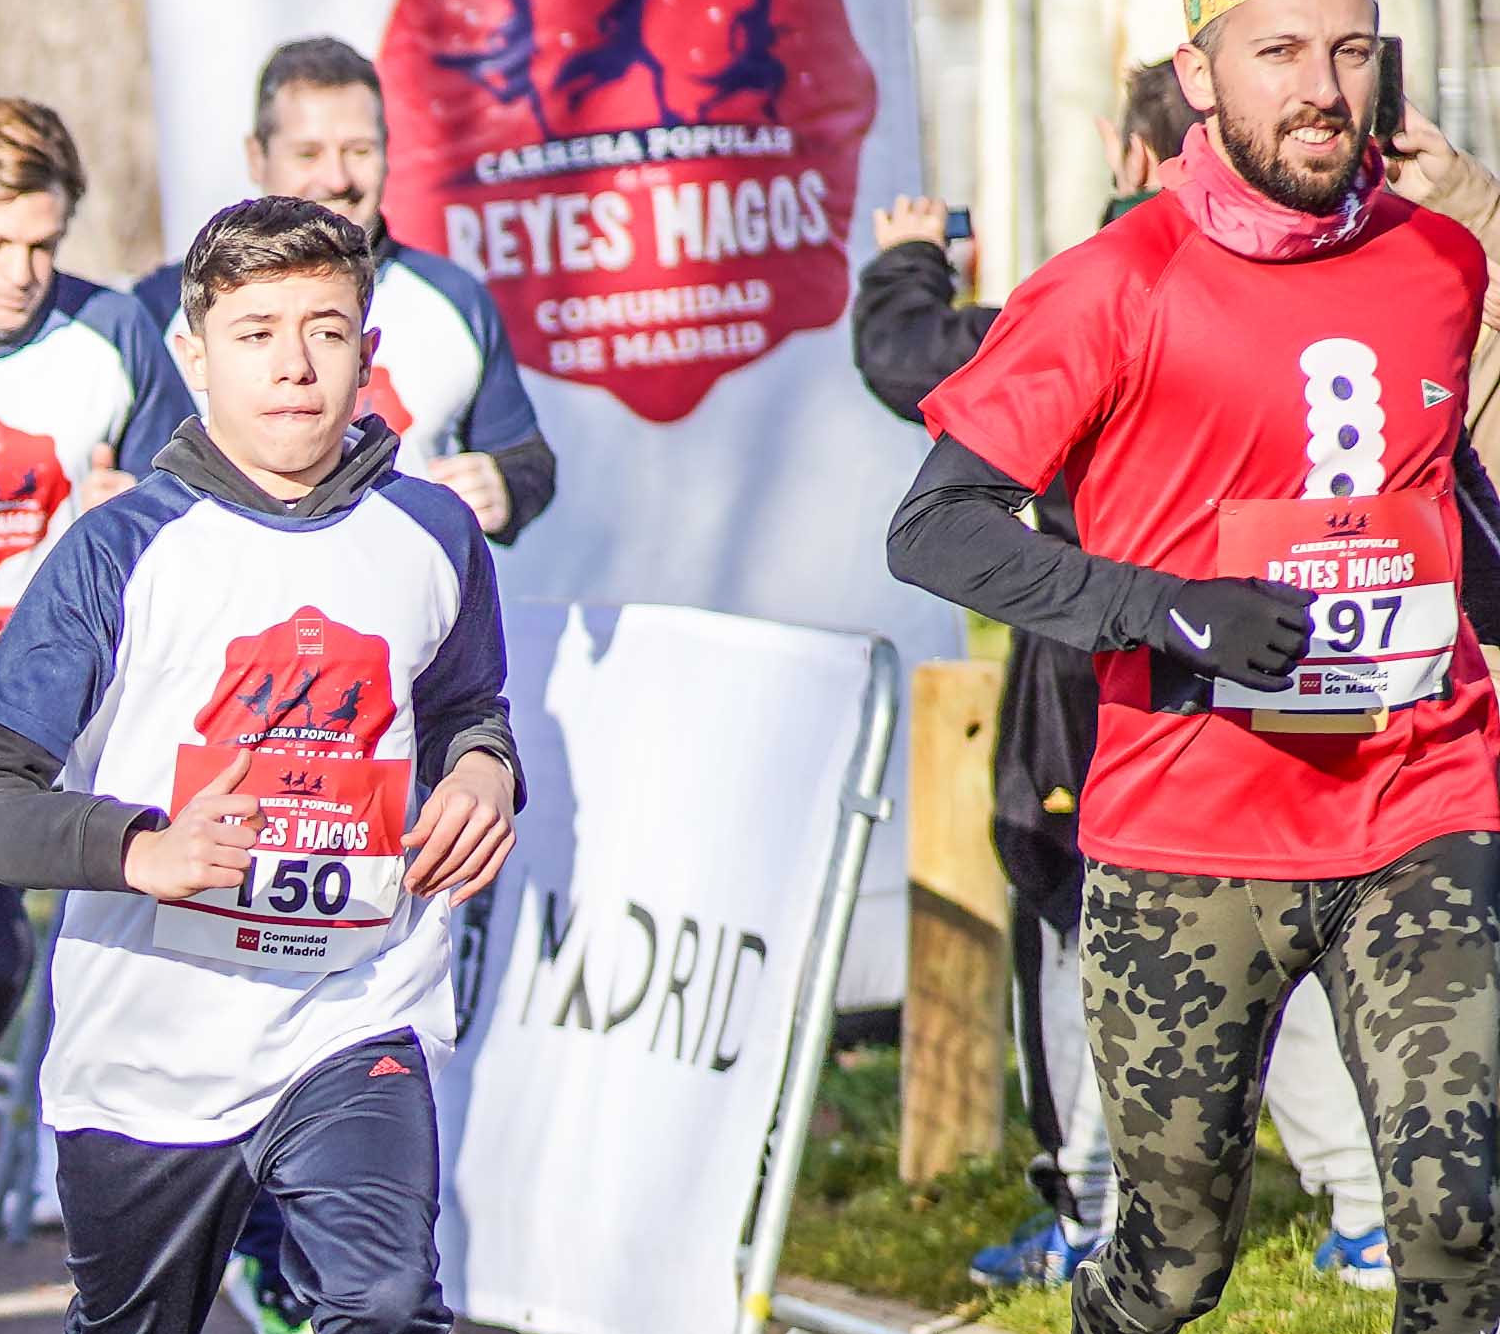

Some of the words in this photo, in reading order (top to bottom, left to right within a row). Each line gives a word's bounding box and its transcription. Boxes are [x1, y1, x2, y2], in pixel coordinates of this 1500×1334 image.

[475, 130, 644, 184] CARRERA
[644, 124, 794, 160] POPULAR
[444, 189, 634, 282] REYES
[649, 168, 831, 268] MAGOS
[535, 279, 772, 334] COMUNIDAD
[549, 338, 604, 371] DE
[613, 321, 767, 367] MADRID
[1268, 559, 1339, 589] REYES
[1347, 553, 1416, 589] MAGOS
[1325, 684, 1340, 695] de
[299, 727, 355, 744] POPULAR
[259, 796, 300, 809] RRERA
[300, 799, 353, 815] POPULAR
[295, 817, 369, 851] MAGOS
[236, 856, 351, 916] 150
[261, 944, 278, 955] de
[282, 946, 326, 957] Madrid
[263, 931, 328, 945] Comunidad
